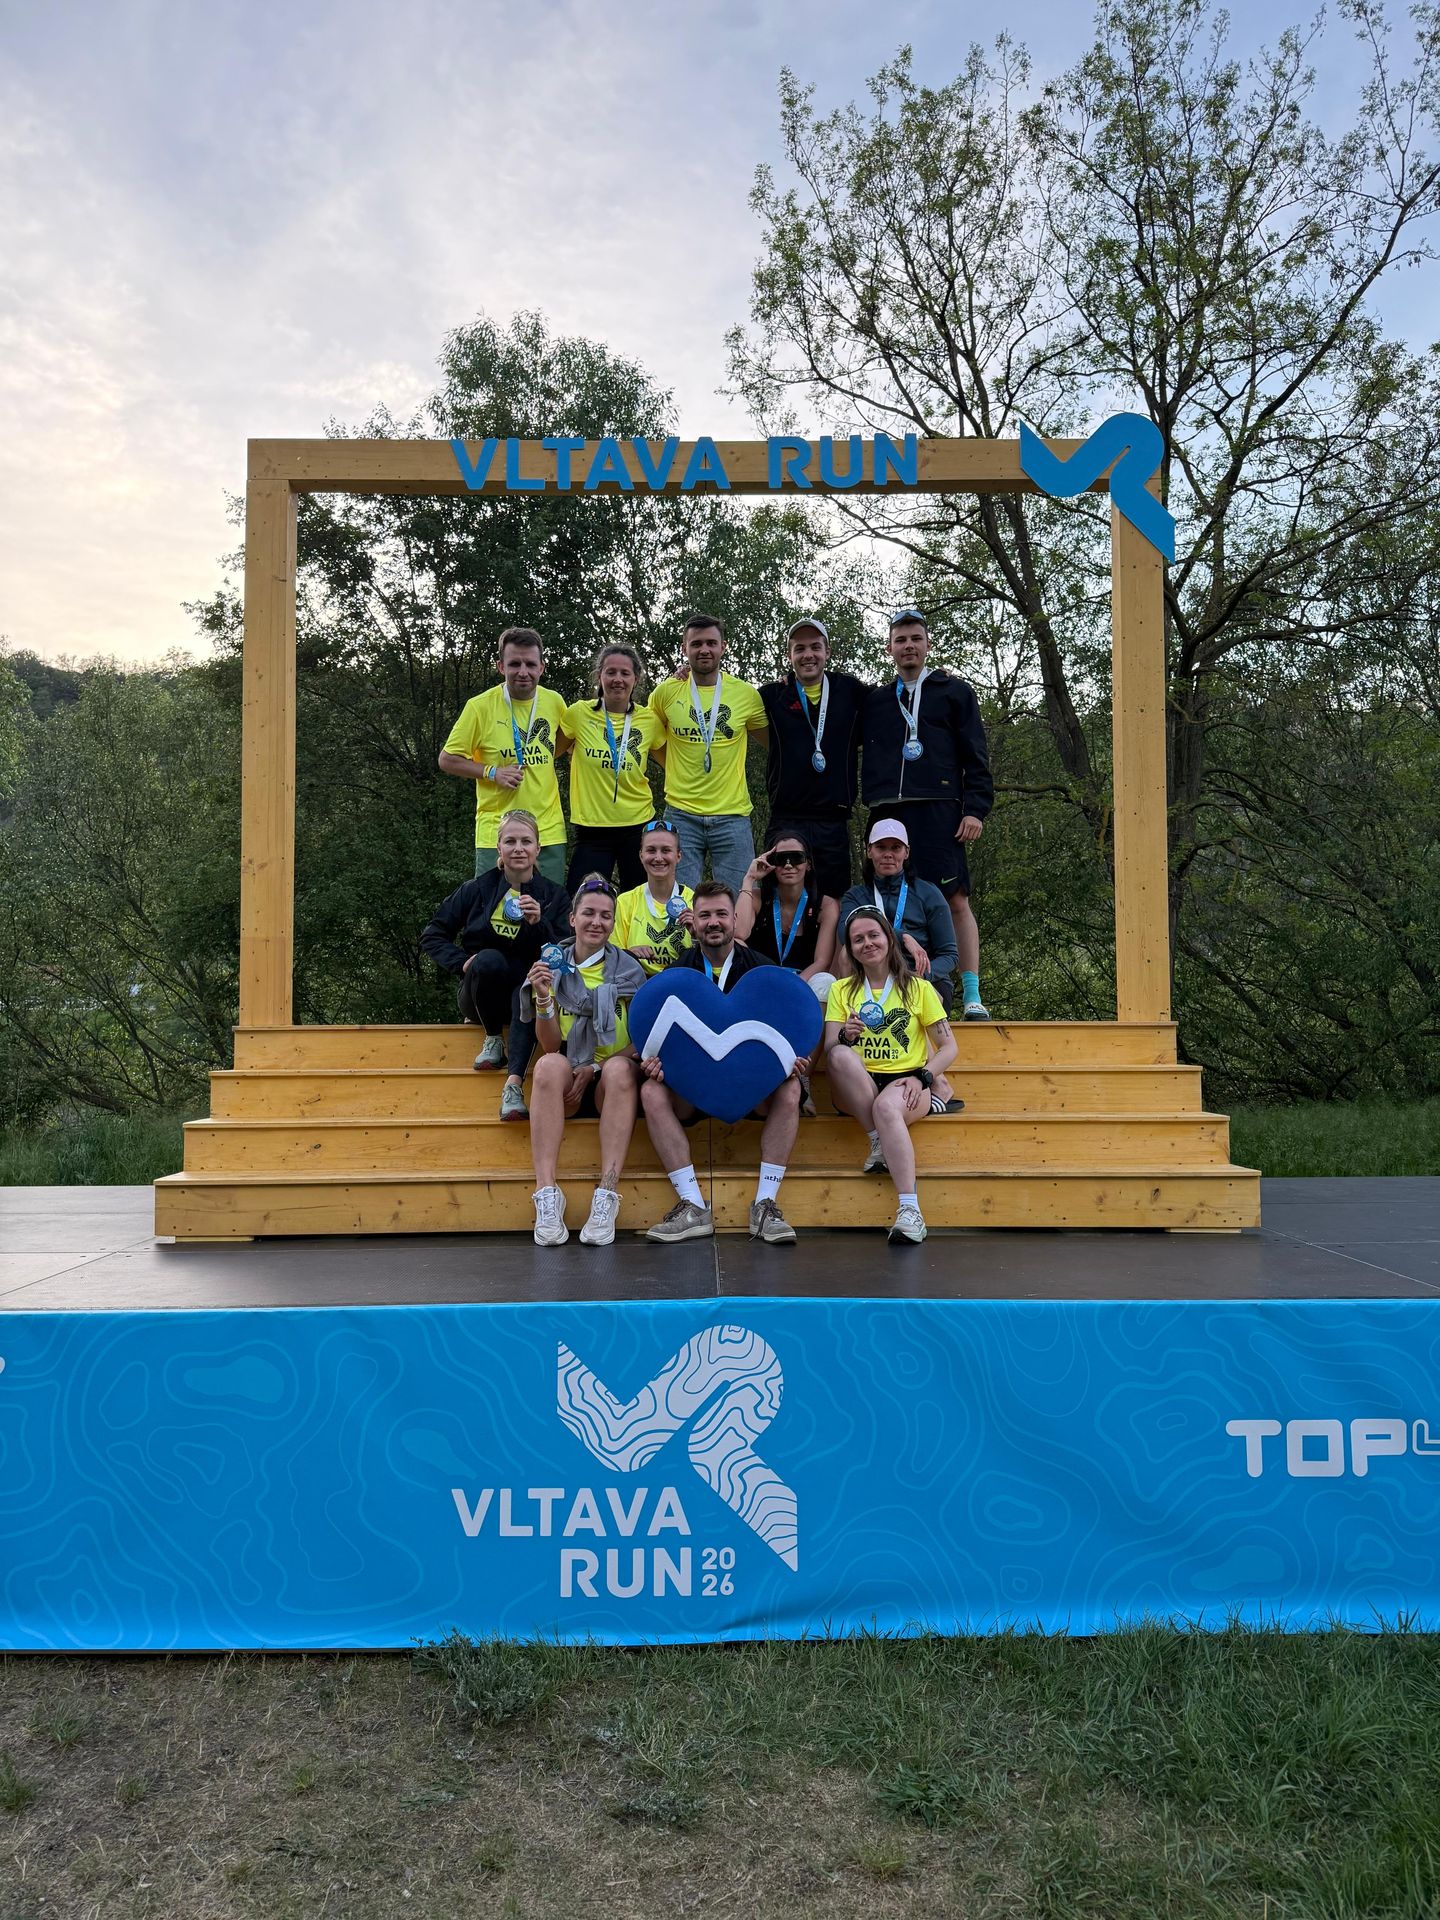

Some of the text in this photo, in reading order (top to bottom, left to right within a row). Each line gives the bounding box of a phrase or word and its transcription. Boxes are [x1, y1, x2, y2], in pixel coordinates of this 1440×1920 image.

[450, 433, 917, 490] VLTAVA RUN
[500, 745, 542, 758] VLAVA
[585, 748, 627, 761] VLTA
[495, 924, 519, 935] TAV
[859, 1037, 891, 1048] TAVA
[864, 1048, 891, 1059] RUN
[764, 1174, 782, 1183] athl
[451, 1487, 692, 1537] VLTAVA
[702, 1547, 736, 1570] 20
[560, 1547, 692, 1598] RUN
[702, 1574, 735, 1597] 26
